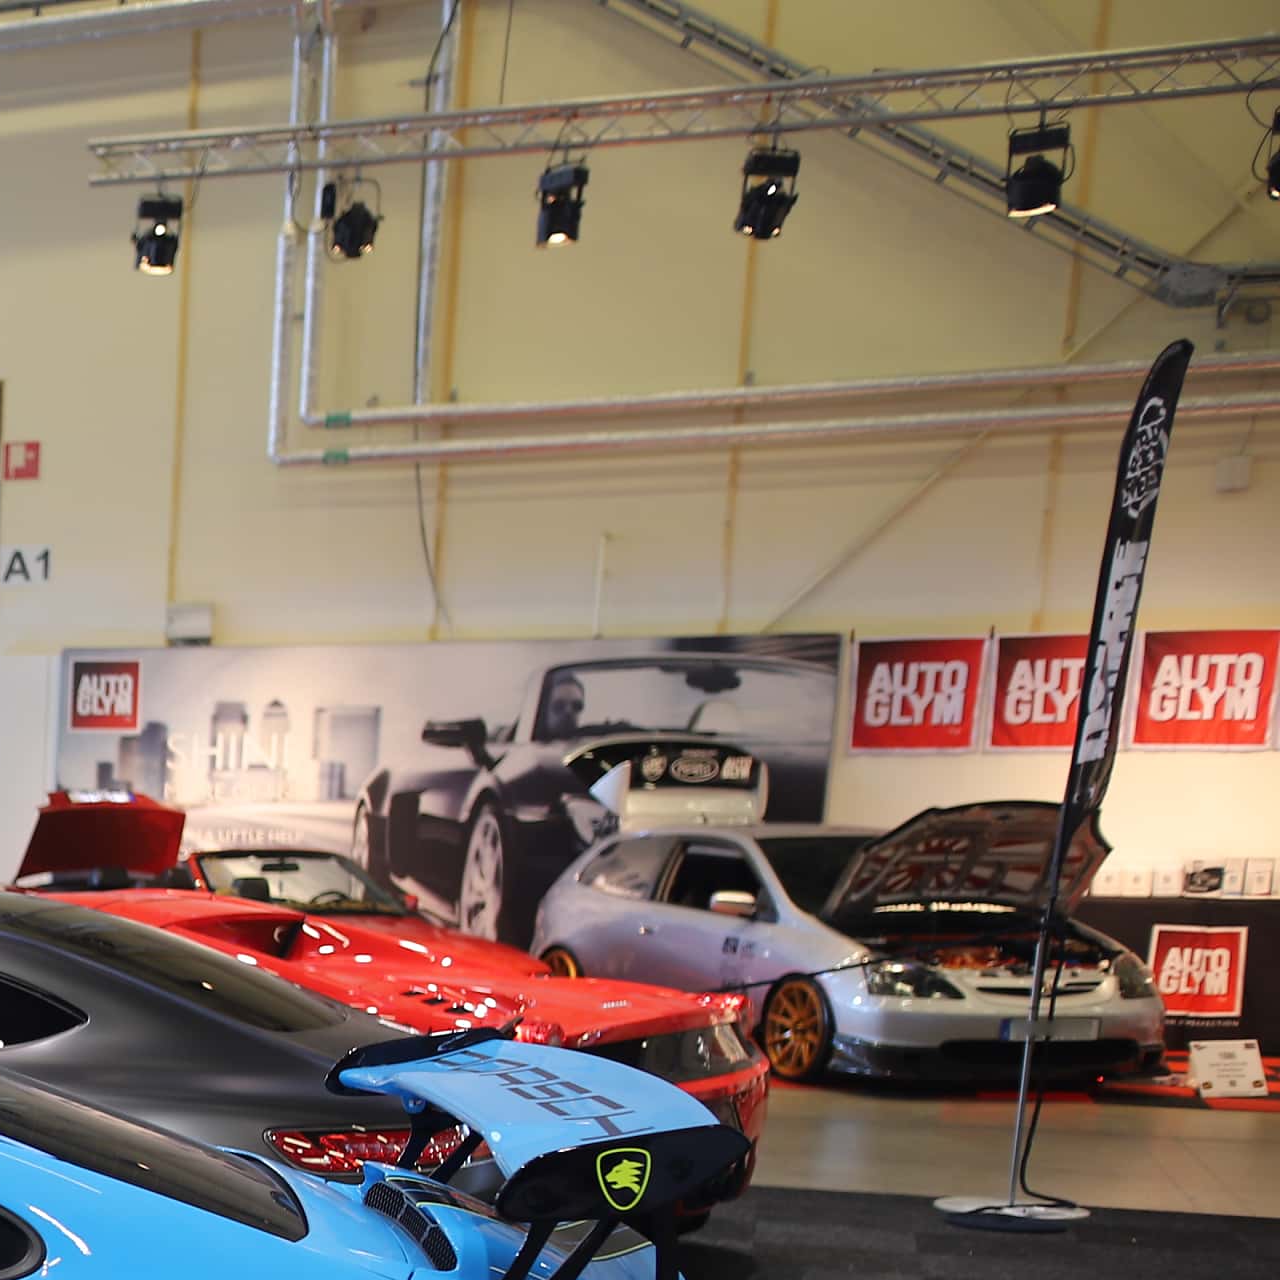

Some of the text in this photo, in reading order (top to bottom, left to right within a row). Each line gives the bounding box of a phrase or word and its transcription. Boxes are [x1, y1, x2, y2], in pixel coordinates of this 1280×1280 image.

[3, 549, 52, 583] A1
[78, 674, 133, 696] AUTO
[868, 660, 969, 696] AUTO
[1007, 658, 1086, 692] AUT
[1152, 652, 1264, 689] AUTO
[76, 693, 133, 717] GLYM
[864, 692, 967, 728] GLYM
[1004, 690, 1084, 725] GLY
[1149, 686, 1260, 722] GLYM
[1162, 946, 1231, 972] AUTO
[1158, 970, 1230, 996] GLYM
